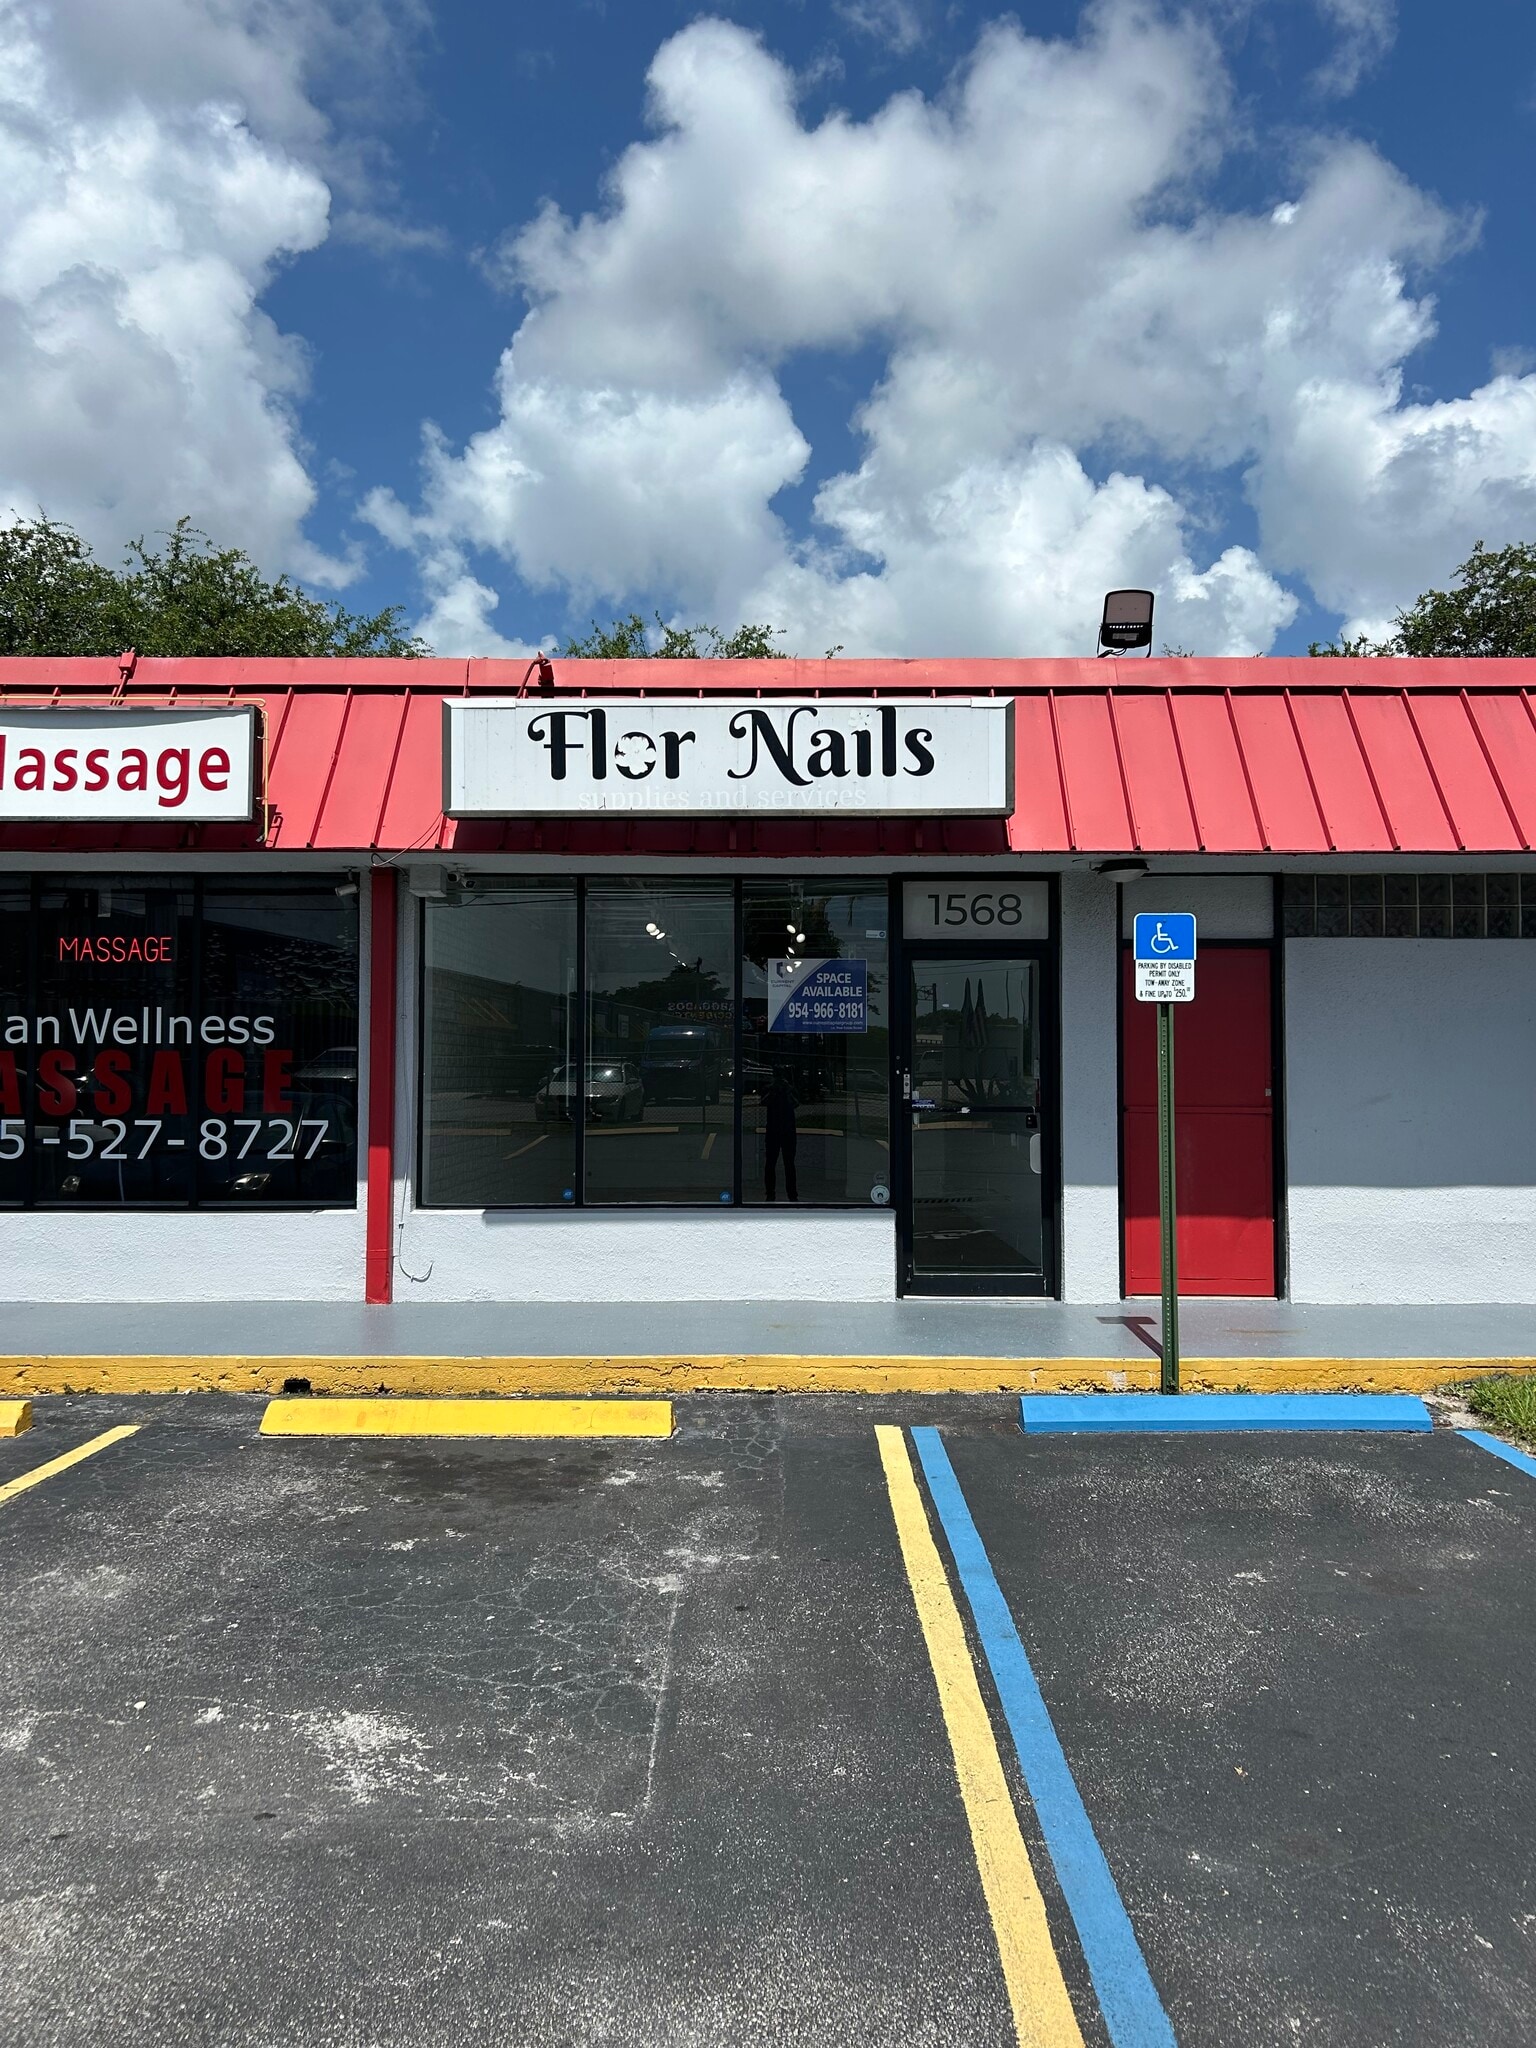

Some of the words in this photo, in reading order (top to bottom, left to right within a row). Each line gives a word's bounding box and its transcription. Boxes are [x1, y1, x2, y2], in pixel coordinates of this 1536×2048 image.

[527, 708, 696, 781] Flor
[727, 706, 935, 786] Nails
[0, 735, 231, 807] assage
[578, 785, 690, 810] supplies
[700, 785, 747, 808] and
[758, 785, 867, 808] services
[927, 893, 1023, 926] 1568
[59, 937, 172, 962] MASSAGE
[1138, 962, 1159, 970] PARKING
[1160, 962, 1166, 970] BY
[1168, 962, 1192, 970] DISABLED
[816, 973, 852, 984] SPACE
[1171, 979, 1185, 987] ZONE
[802, 986, 863, 997] AVAILABLE
[788, 1002, 864, 1019] 954-966-8181
